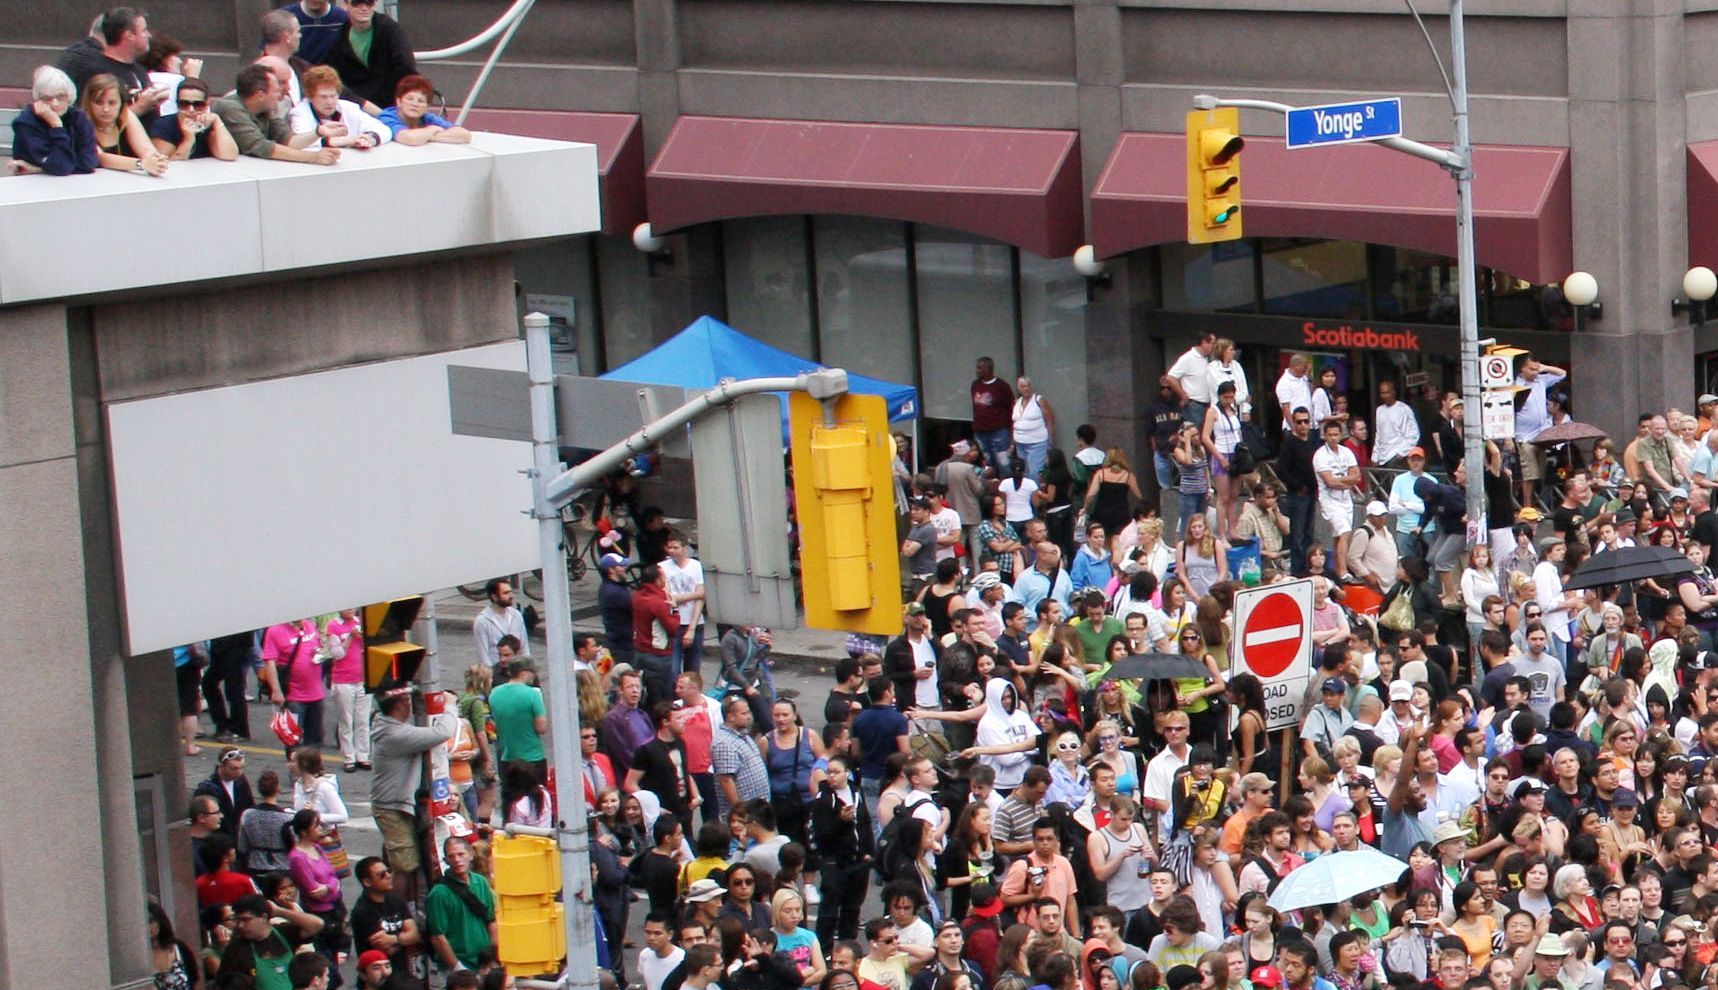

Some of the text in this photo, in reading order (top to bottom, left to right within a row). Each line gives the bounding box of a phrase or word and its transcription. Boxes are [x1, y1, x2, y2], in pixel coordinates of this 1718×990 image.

[1314, 106, 1375, 138] Yonge St
[1303, 322, 1419, 350] Scotiabank
[1262, 684, 1288, 701] OAD
[1263, 703, 1295, 720] OSED
